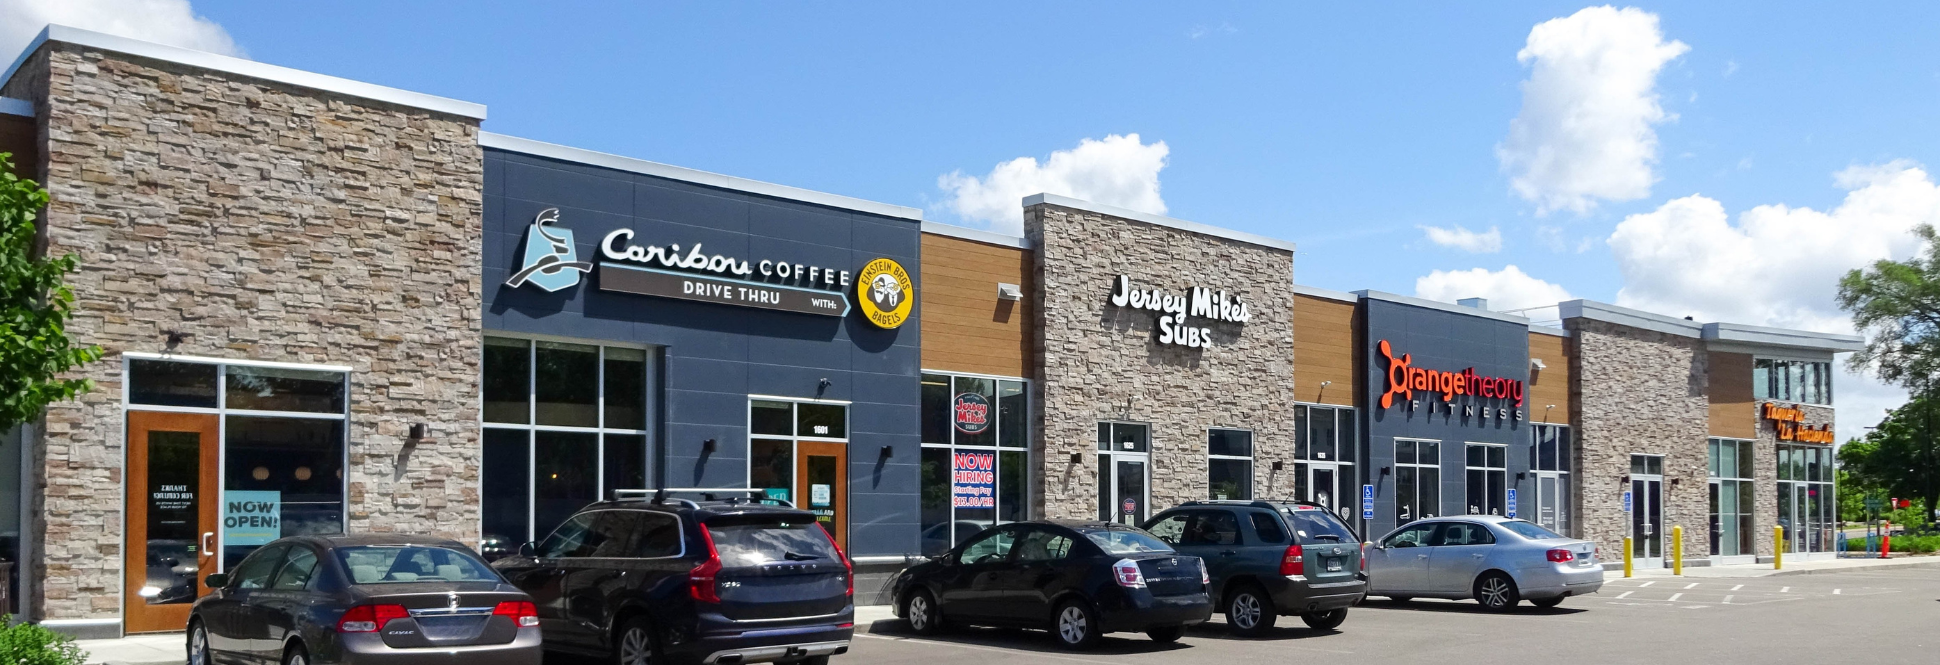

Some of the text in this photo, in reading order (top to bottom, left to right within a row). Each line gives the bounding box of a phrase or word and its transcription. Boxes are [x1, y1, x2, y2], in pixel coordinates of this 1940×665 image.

[601, 228, 849, 286] Caribou COFFEE
[861, 261, 910, 291] EINSTEIN BROS
[683, 280, 837, 309] DRIVE THRU WITH:
[1112, 274, 1252, 324] Jersey Mike's
[871, 310, 901, 325] BAGELS
[1159, 316, 1212, 348] SUBS
[955, 398, 987, 415] Jersey
[1412, 400, 1523, 421] FITNESS
[813, 425, 829, 435] 1601
[954, 453, 994, 470] NOW
[954, 470, 994, 484] HIRING
[954, 486, 992, 496] Starting Pay
[229, 501, 274, 513] NOW
[224, 516, 278, 529] OPEN!
